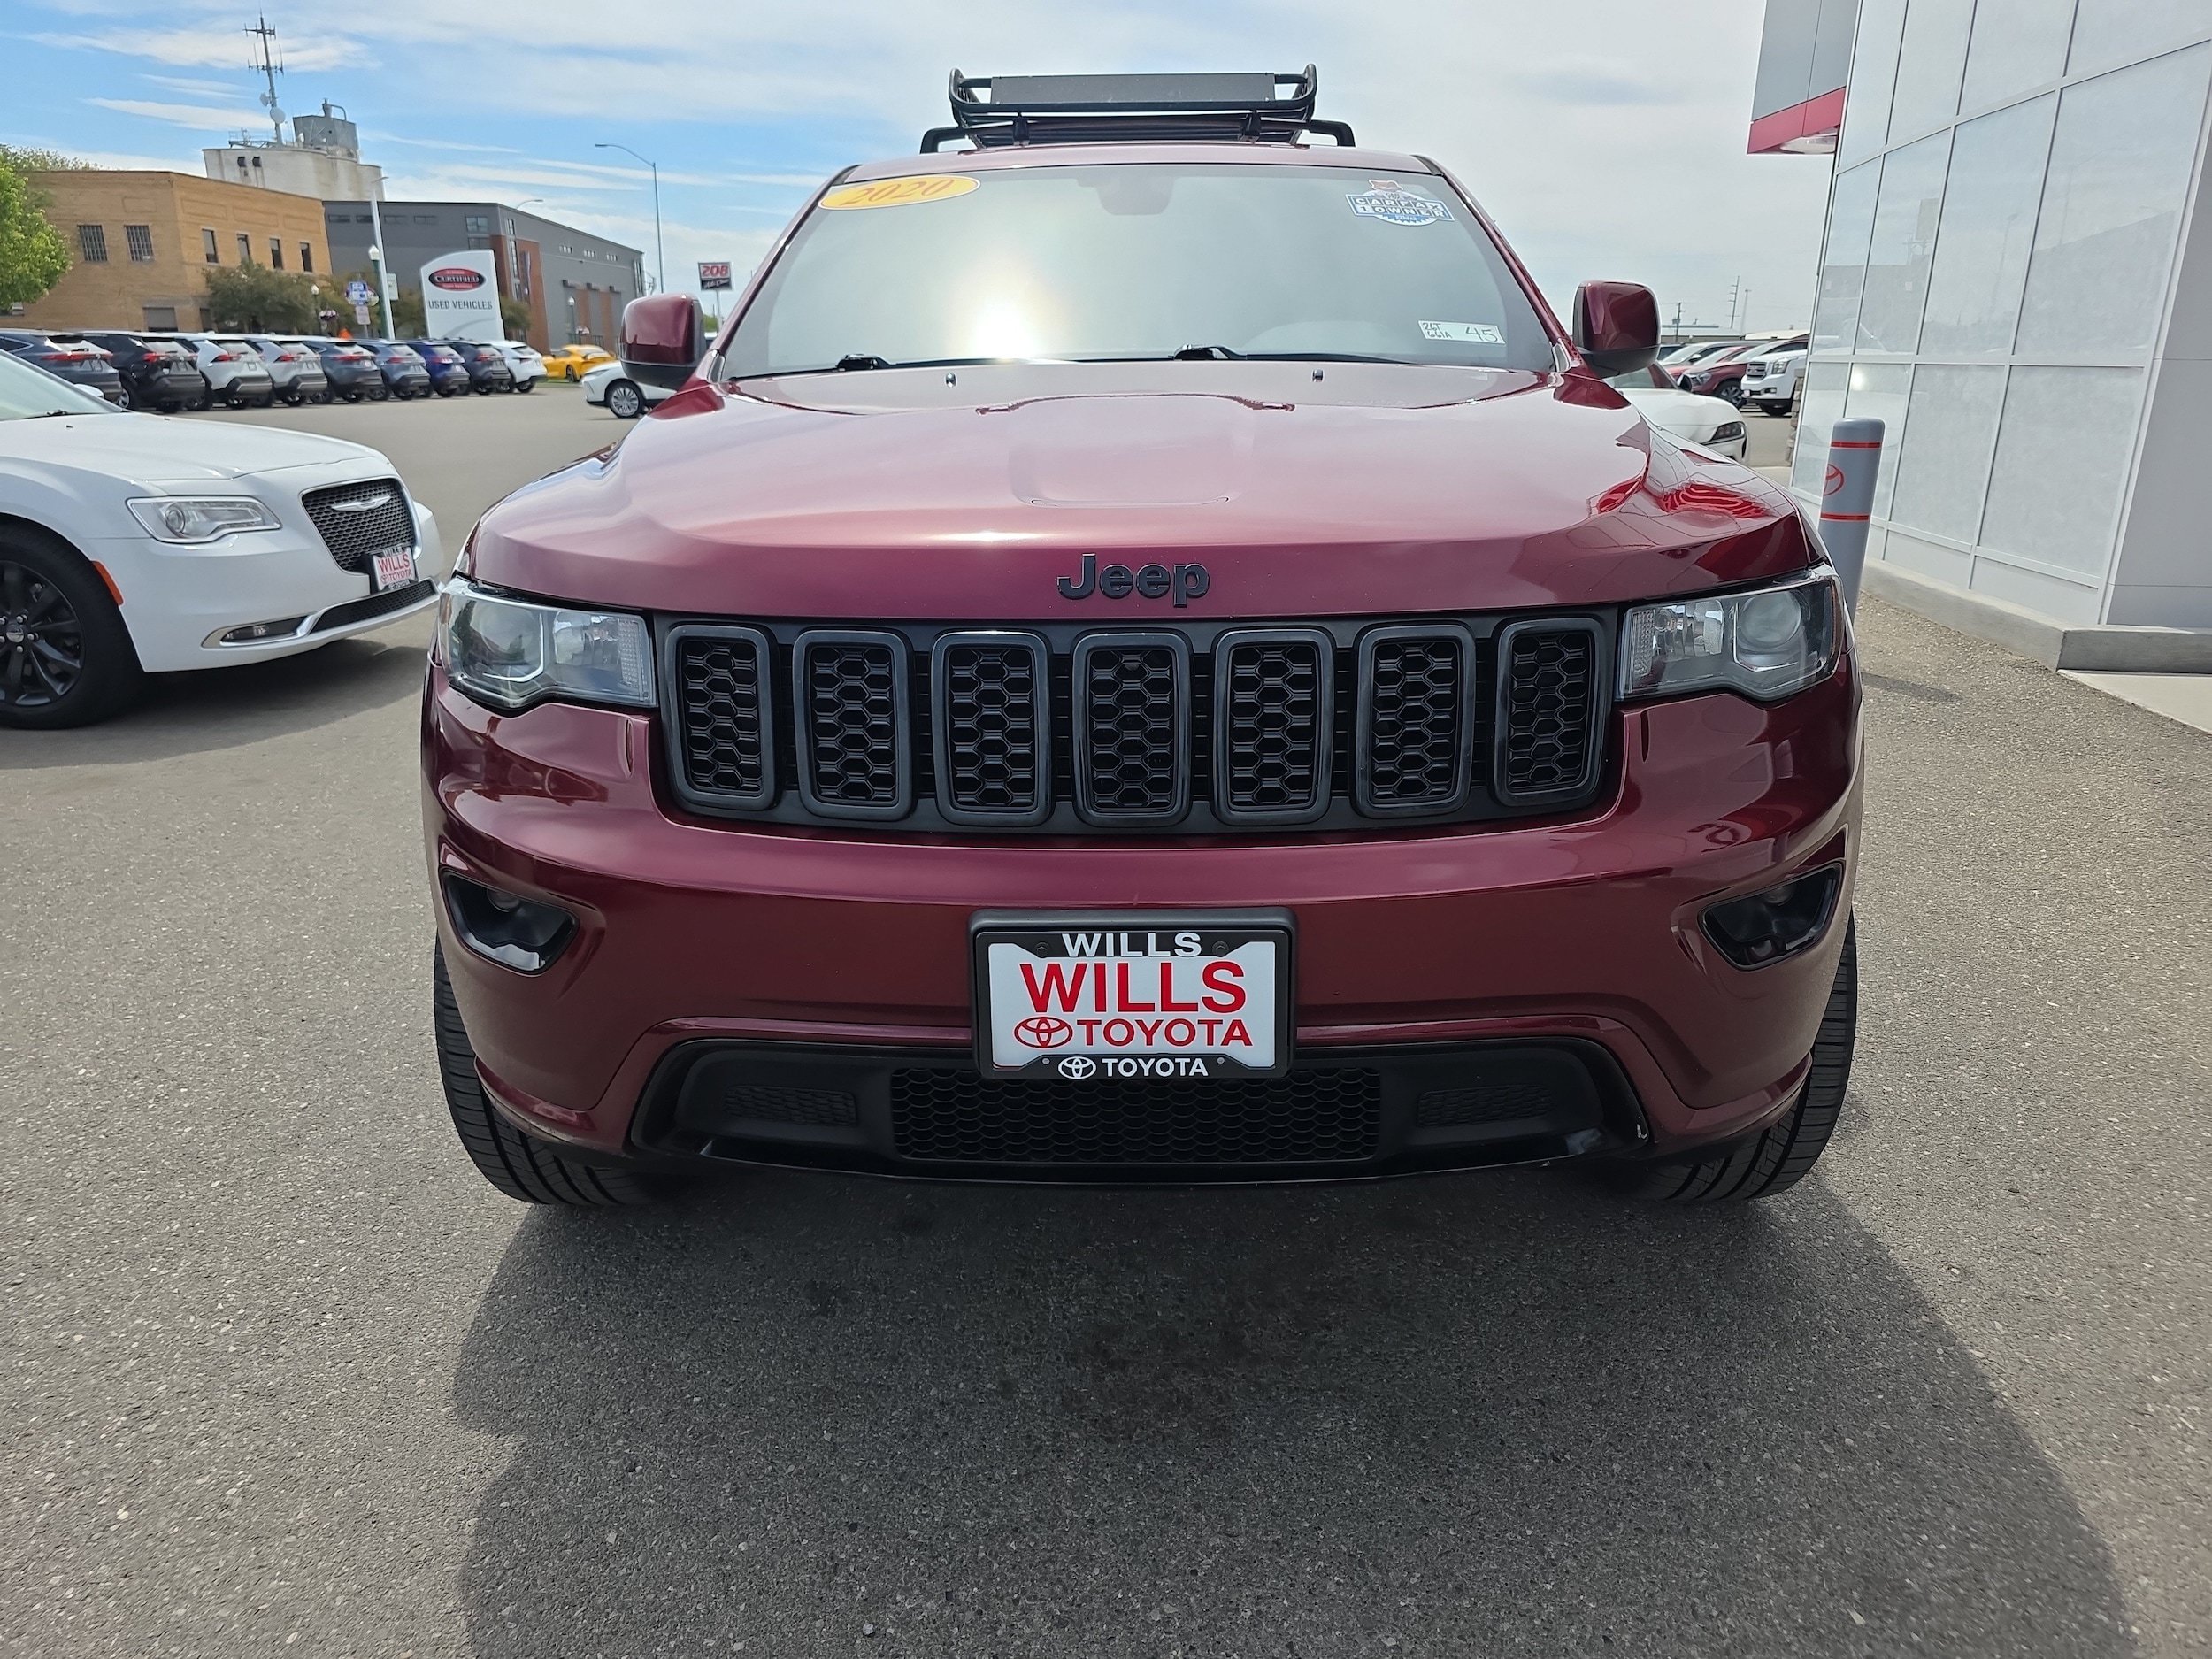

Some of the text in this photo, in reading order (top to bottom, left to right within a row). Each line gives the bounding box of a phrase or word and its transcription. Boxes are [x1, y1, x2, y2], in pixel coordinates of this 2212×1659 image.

[840, 179, 955, 206] 2020
[1355, 197, 1441, 211] CARFAX
[1373, 205, 1446, 218] OWNER
[702, 265, 729, 277] 208
[428, 300, 493, 311] USED VEHICLES
[1465, 326, 1498, 342] 45
[378, 553, 411, 573] WILLS
[388, 568, 411, 580] TOYOTA
[1057, 553, 1210, 608] Jeep
[1062, 933, 1202, 957] WILLS
[1019, 961, 1247, 1013] WILLS
[1077, 1018, 1253, 1047] TOYOTA
[1102, 1057, 1210, 1077] TOYOTA
